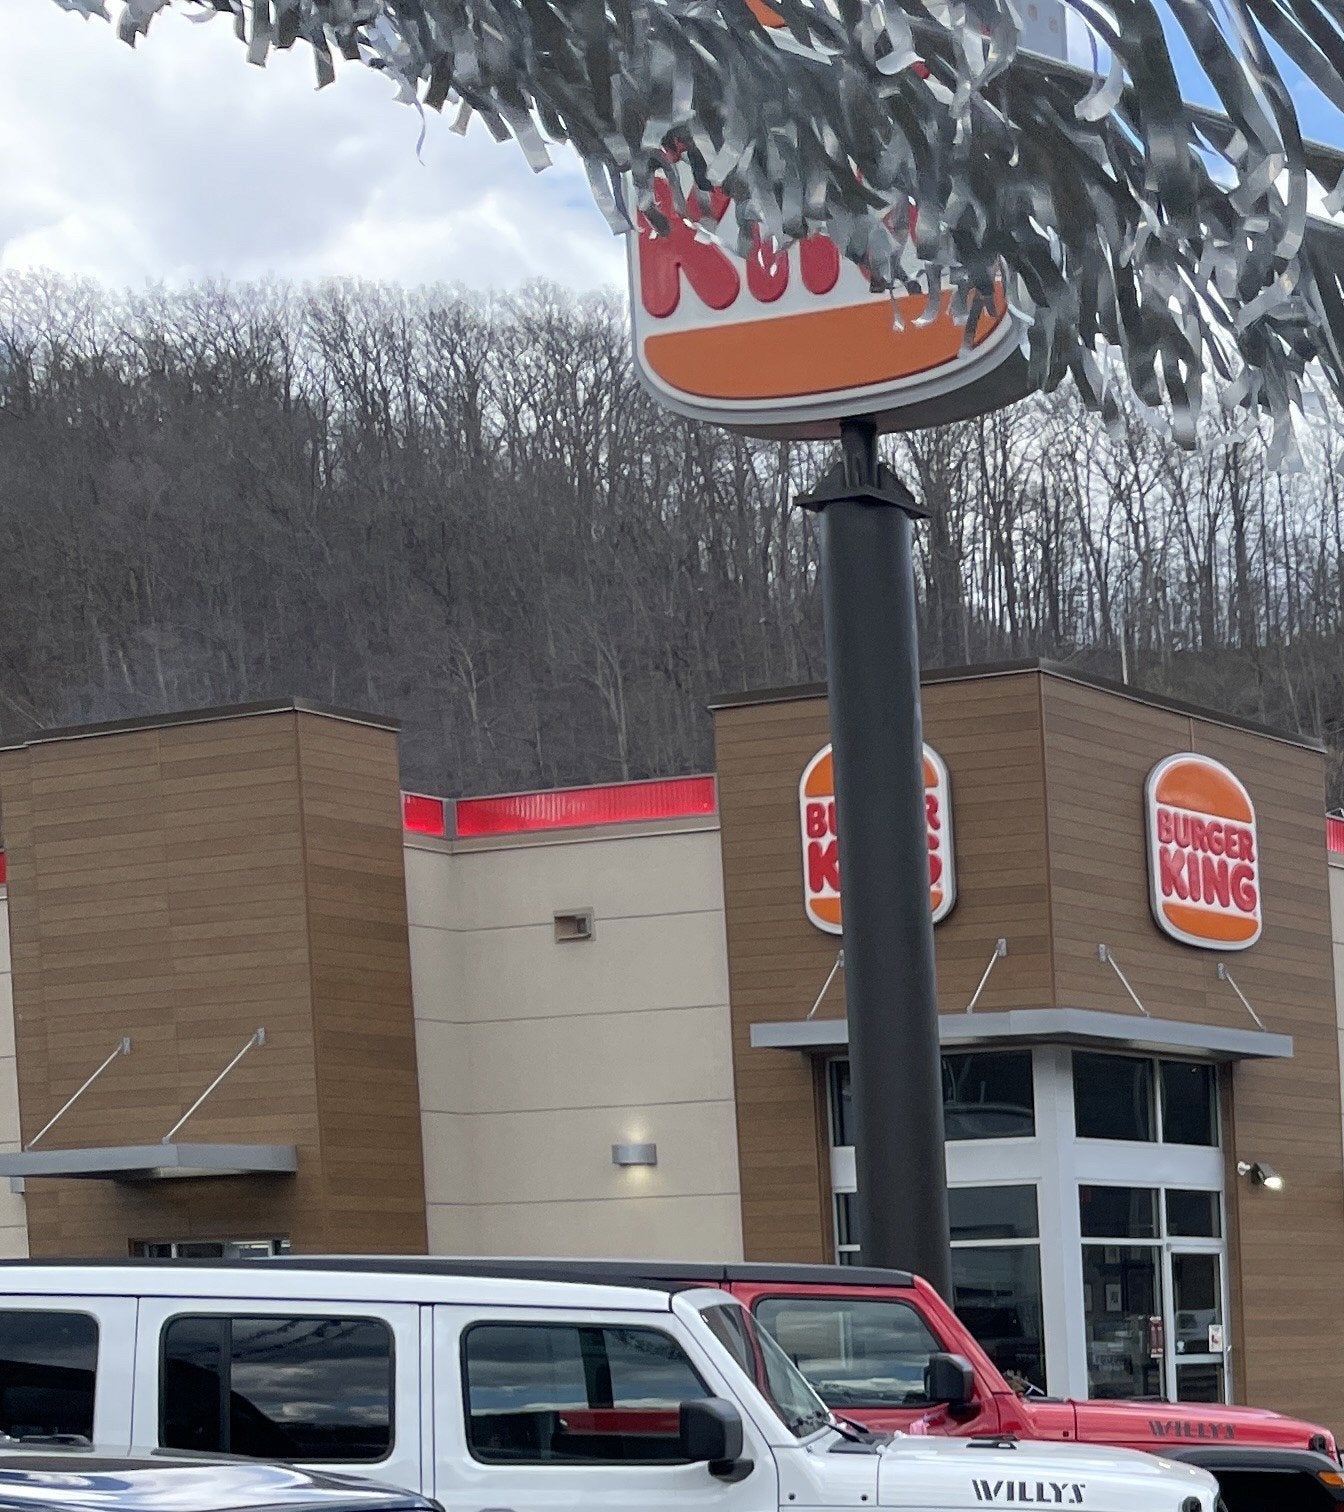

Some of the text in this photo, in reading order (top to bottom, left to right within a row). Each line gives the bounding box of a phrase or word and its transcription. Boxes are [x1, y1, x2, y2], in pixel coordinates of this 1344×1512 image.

[1157, 808, 1254, 862] BURGER
[1159, 846, 1257, 912] KING
[1148, 1420, 1235, 1440] WILLYS
[971, 1479, 1086, 1503] WILLYS
